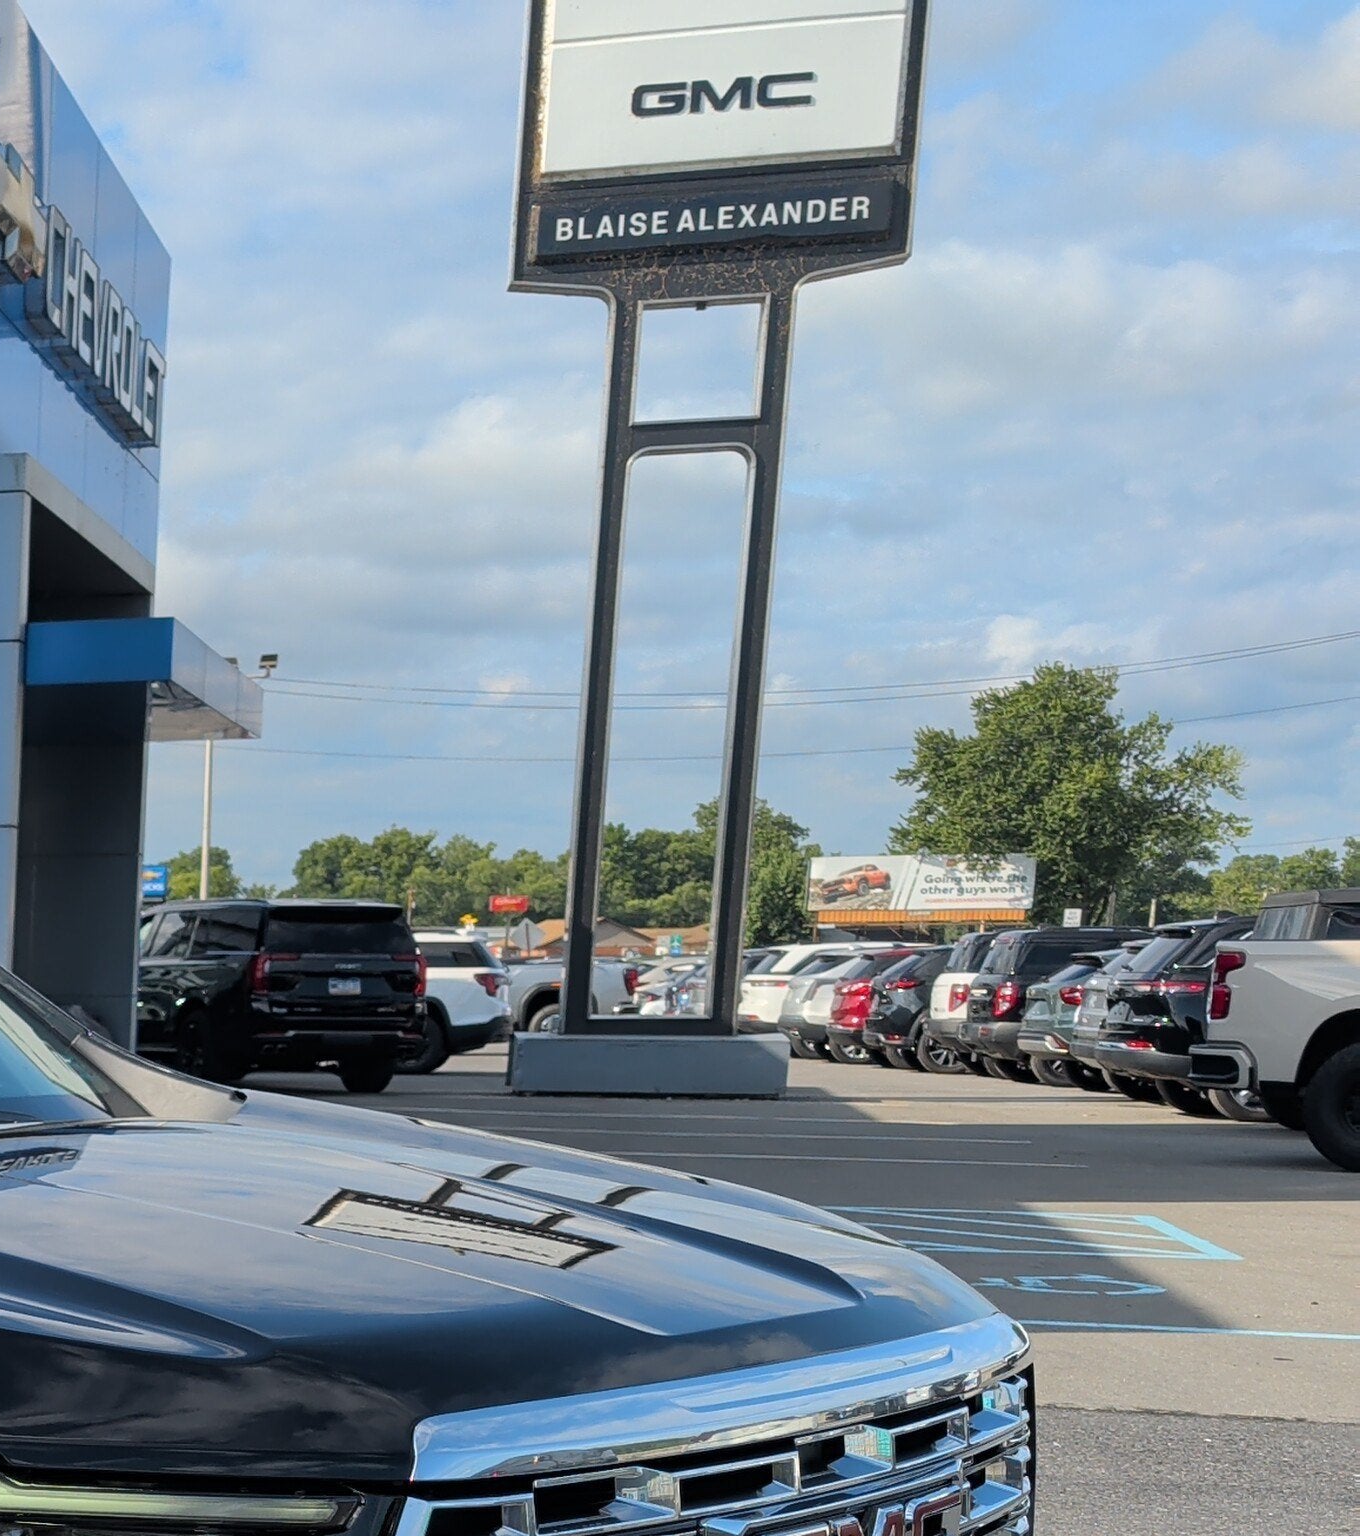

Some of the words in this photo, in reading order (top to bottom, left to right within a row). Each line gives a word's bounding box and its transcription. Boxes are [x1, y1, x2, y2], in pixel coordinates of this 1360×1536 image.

[630, 72, 817, 117] GMC
[555, 210, 668, 242] BLAISE
[676, 196, 871, 232] ALEXANDER
[43, 204, 167, 447] CHEVROLET
